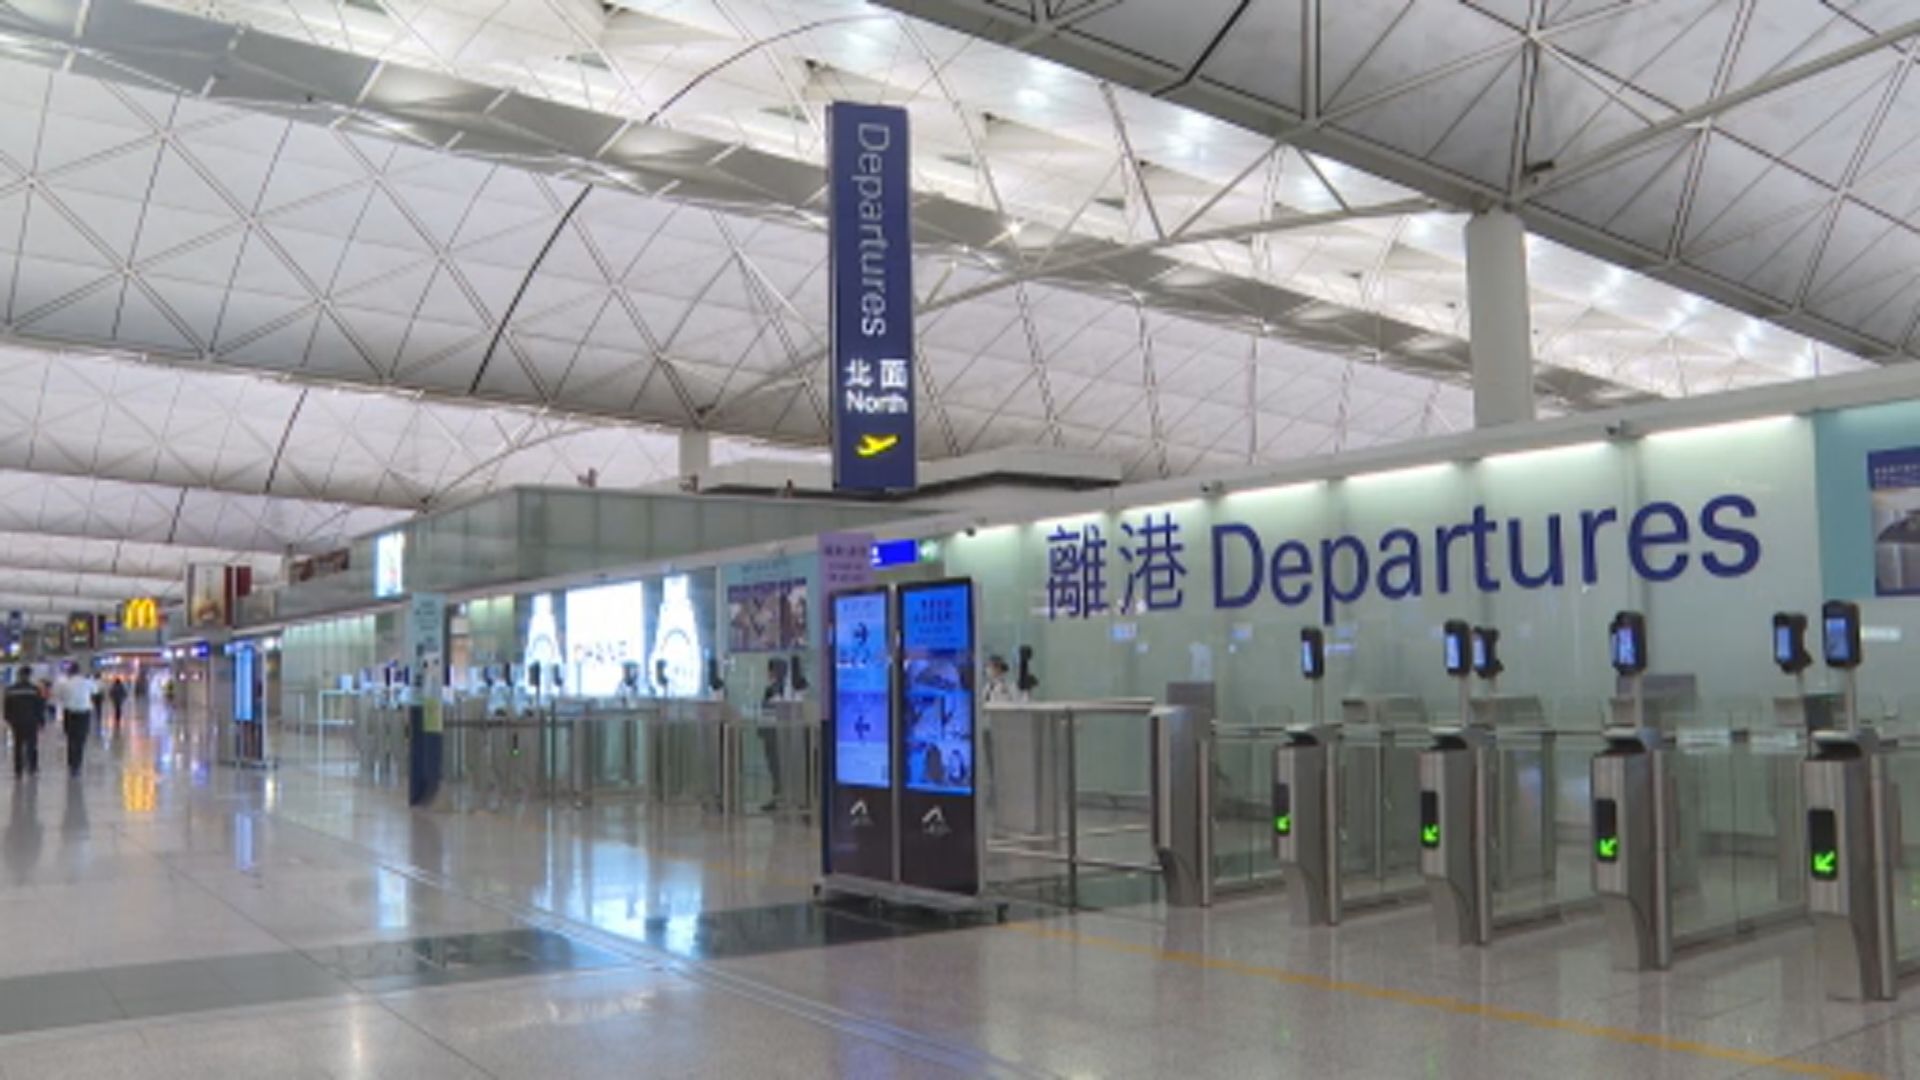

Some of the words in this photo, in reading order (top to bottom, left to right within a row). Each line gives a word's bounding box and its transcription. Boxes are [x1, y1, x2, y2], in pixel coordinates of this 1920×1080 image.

[852, 122, 890, 337] Departures
[846, 390, 908, 413] North
[1046, 512, 1188, 621] 離港
[1212, 494, 1760, 626] Departures
